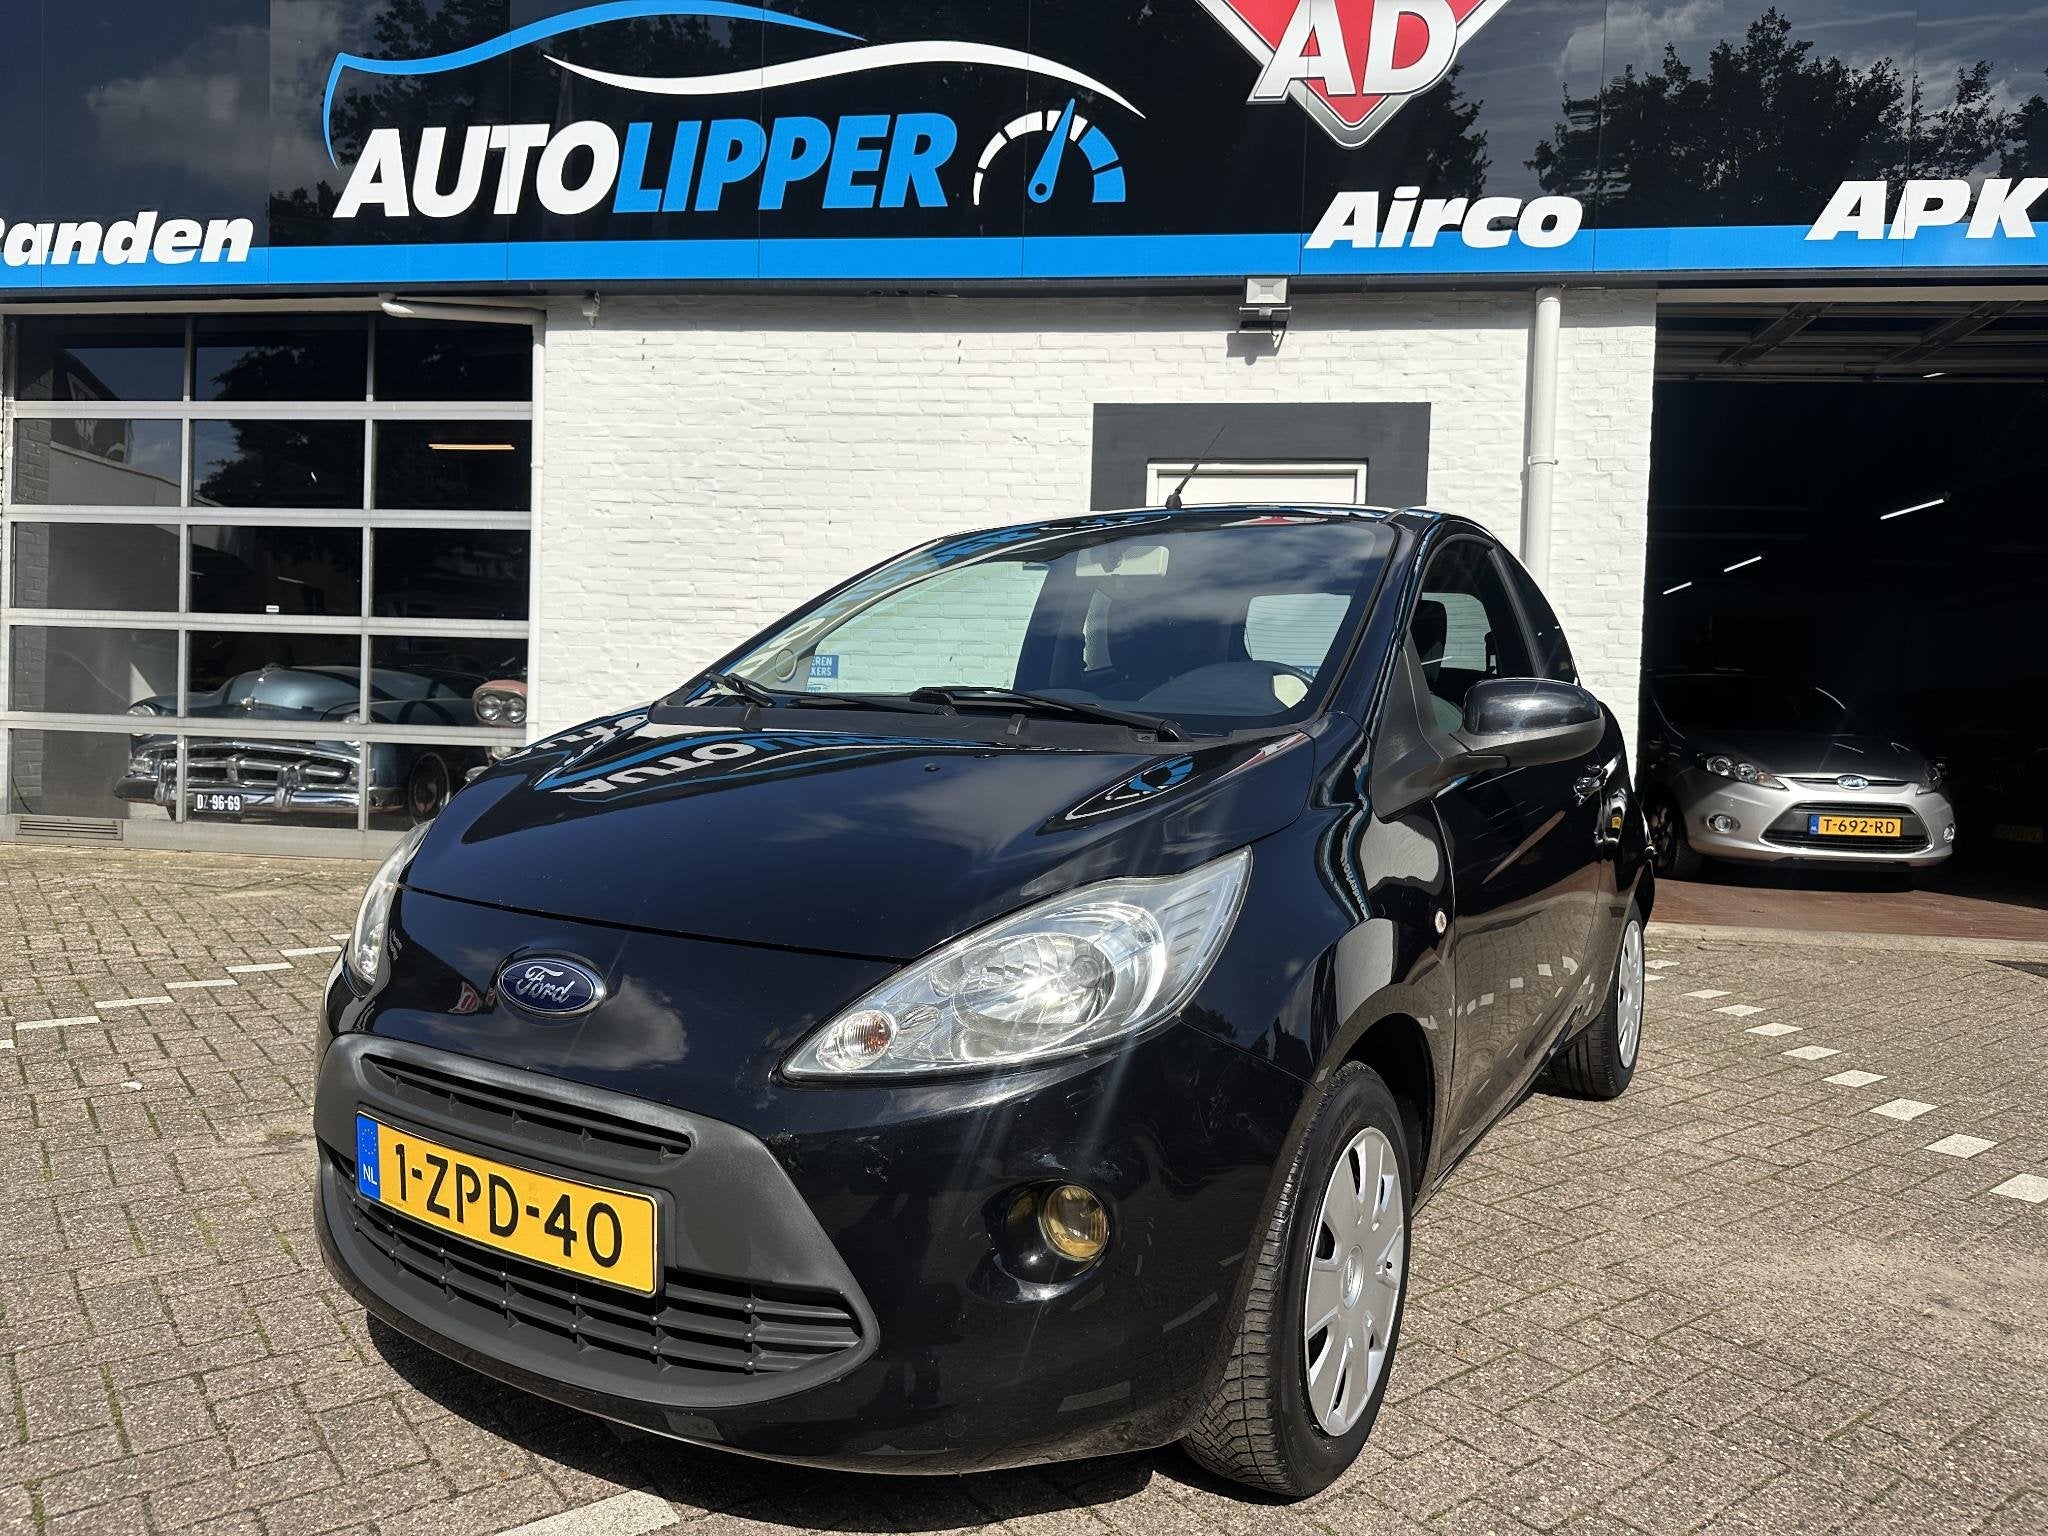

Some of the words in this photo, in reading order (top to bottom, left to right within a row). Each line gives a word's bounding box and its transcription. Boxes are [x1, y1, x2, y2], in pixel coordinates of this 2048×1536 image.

[1250, 0, 1458, 100] AD
[1304, 186, 1583, 249] Airco
[1804, 178, 2048, 241] APK
[0, 211, 254, 267] anden
[810, 667, 833, 677] KERS
[197, 794, 241, 811] DZ-96-69
[1823, 819, 1896, 834] T-692-RD
[515, 965, 576, 1004] Ford
[362, 1164, 378, 1186] NL
[395, 1143, 623, 1268] 1-ZPD-40
